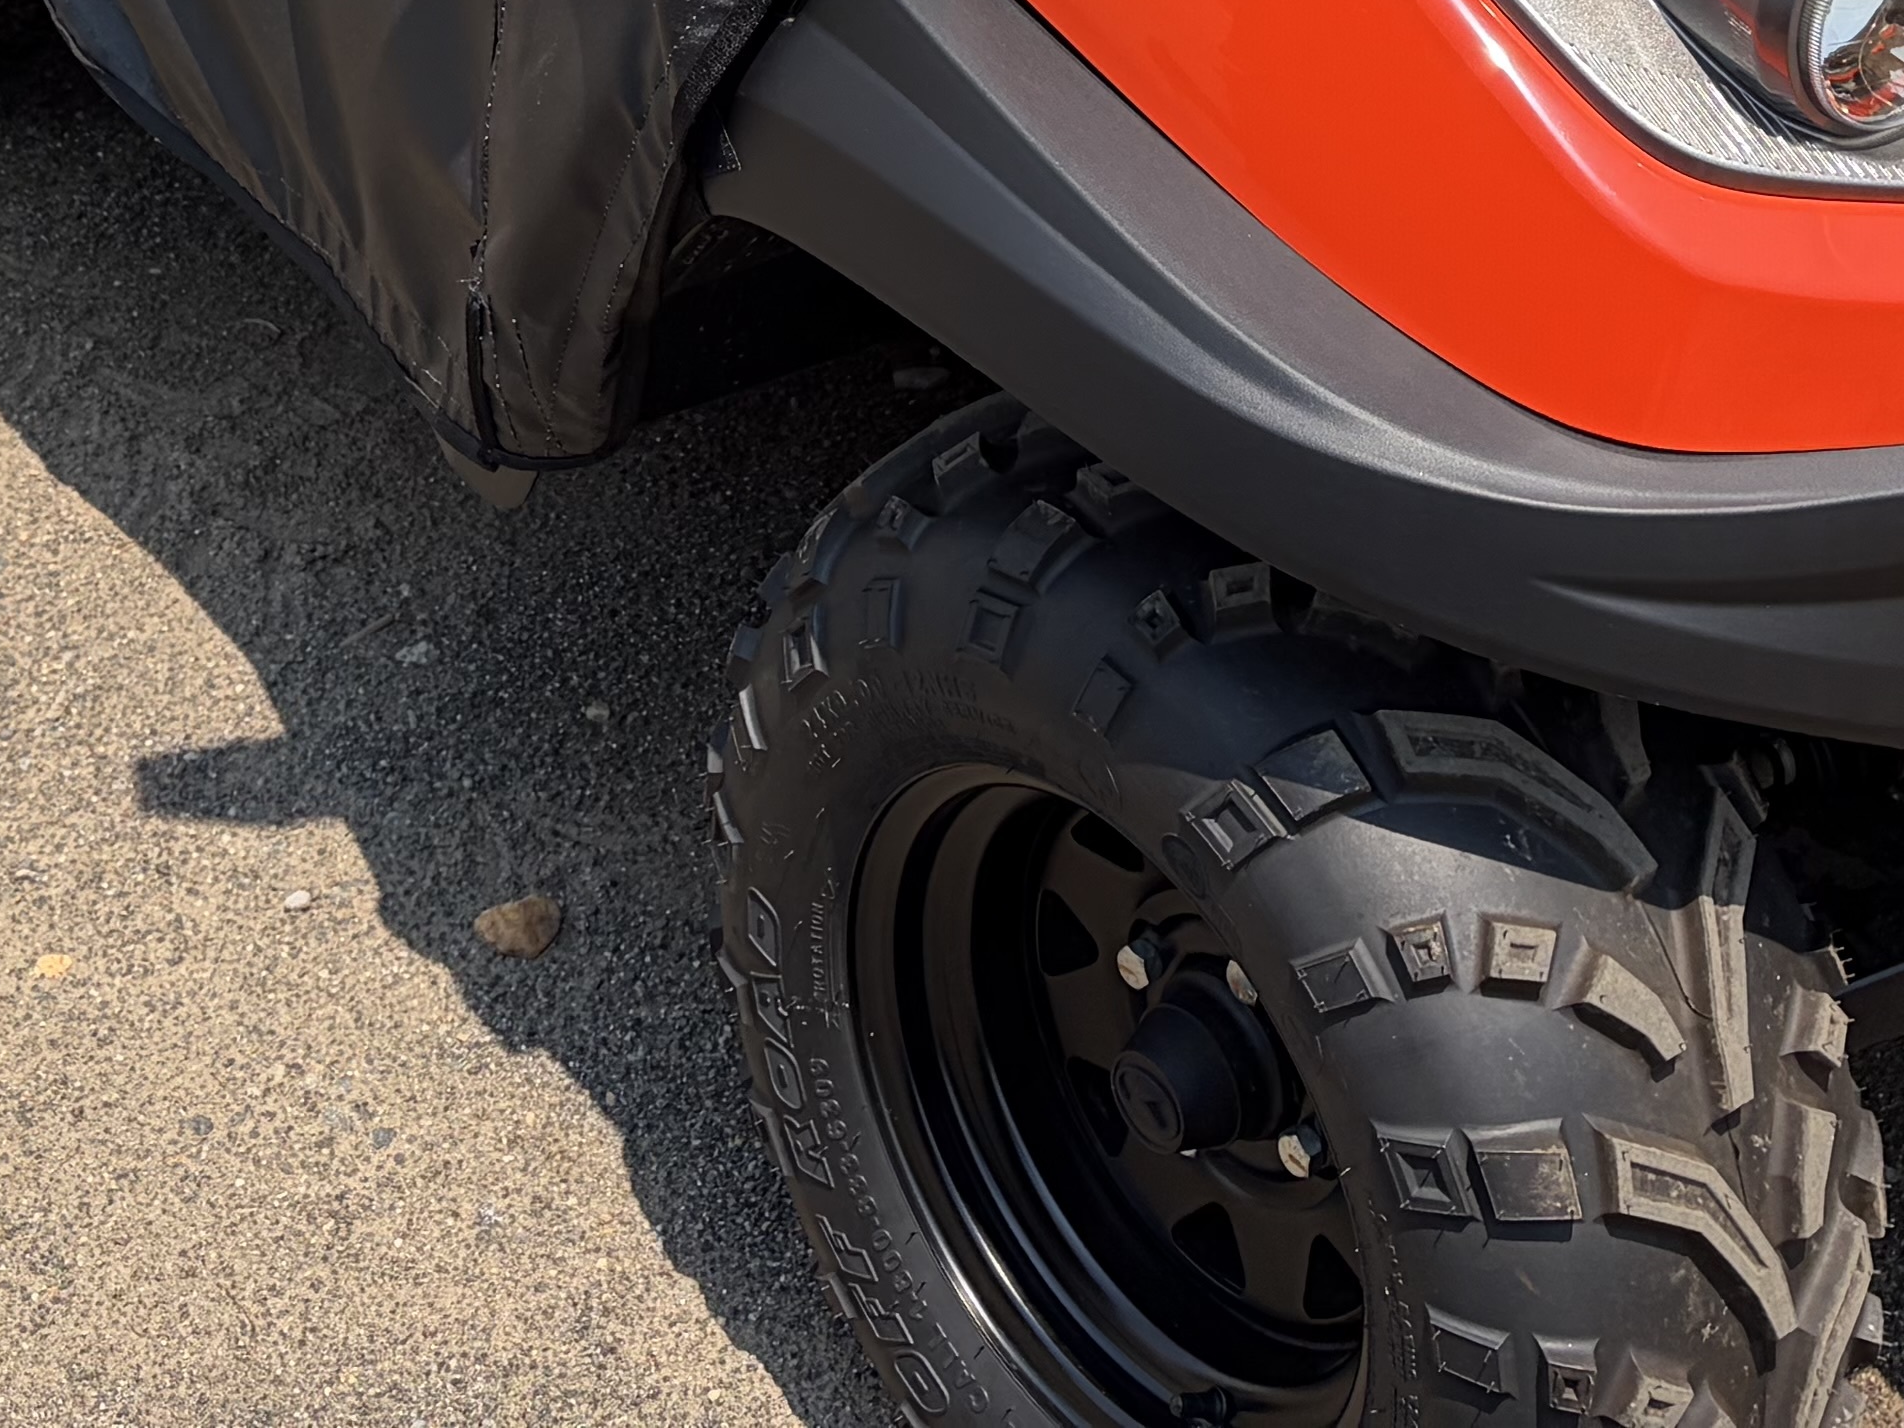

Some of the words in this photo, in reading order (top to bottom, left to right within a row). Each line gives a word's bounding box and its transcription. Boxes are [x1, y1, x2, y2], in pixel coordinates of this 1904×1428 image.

[809, 900, 826, 999] ROTATION
[746, 886, 836, 1190] ROAD
[814, 1213, 952, 1417] OFF
[927, 1321, 992, 1415] CALL
